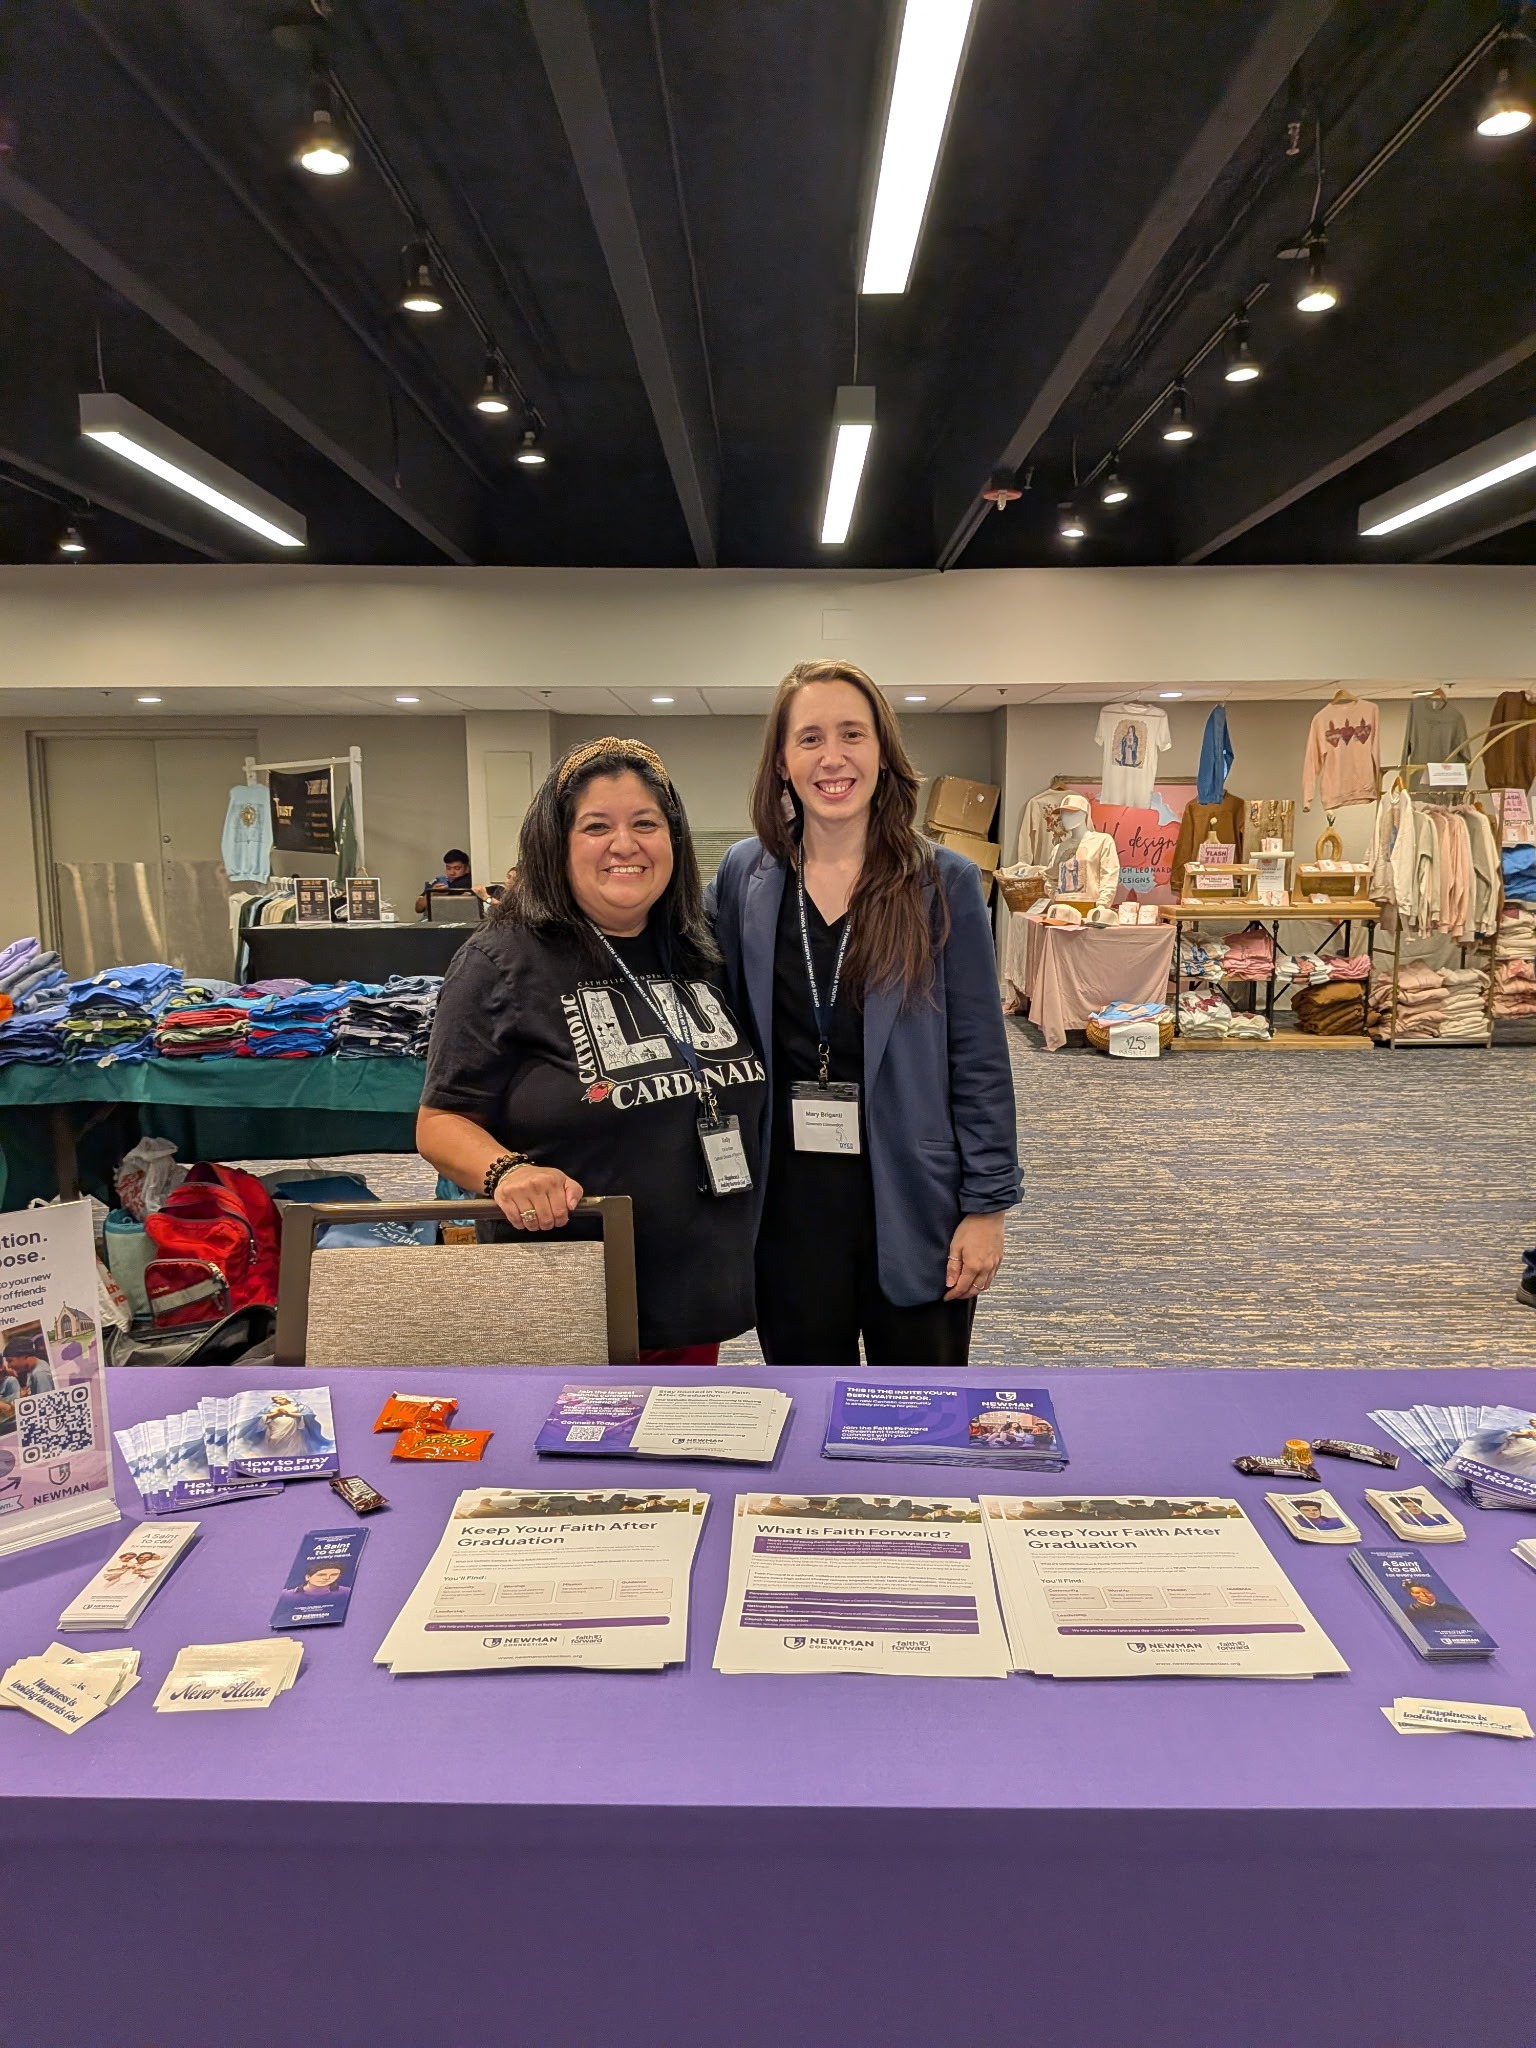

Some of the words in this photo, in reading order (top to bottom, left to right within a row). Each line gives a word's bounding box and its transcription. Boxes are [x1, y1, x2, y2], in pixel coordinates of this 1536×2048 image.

[1135, 866, 1171, 874] LEONARD
[1119, 876, 1150, 884] DESIGNS
[616, 957, 631, 975] OFFICE
[577, 977, 625, 988] CATHOLIC
[811, 988, 821, 1008] OFFICE
[560, 993, 598, 1085] CATHOLIC
[805, 1111, 820, 1119] Mary
[0, 1231, 48, 1250] tion.
[9, 1277, 30, 1290] your
[29, 1272, 51, 1282] new
[14, 1285, 47, 1299] friends
[241, 1459, 275, 1468] How
[296, 1456, 329, 1465] Pray
[246, 1465, 271, 1474] the
[273, 1463, 325, 1473] Rosary
[1456, 1458, 1492, 1474] How
[1494, 1471, 1511, 1482] to
[1458, 1464, 1483, 1477] the
[33, 1482, 90, 1506] NEWMAN
[189, 1487, 215, 1496] the
[461, 1525, 510, 1536] Keep
[515, 1525, 556, 1534] Your
[560, 1523, 605, 1533] Faith
[609, 1521, 658, 1531] After
[757, 1524, 803, 1535] What
[805, 1527, 820, 1535] is
[823, 1527, 865, 1536] Faith
[868, 1528, 951, 1539] Forward?
[1023, 1528, 1074, 1539] Keep
[1076, 1528, 1121, 1538] Your
[1122, 1527, 1170, 1537] Faith
[1173, 1526, 1221, 1537] After
[323, 1542, 351, 1550] Saint
[457, 1536, 565, 1547] Graduation
[1028, 1539, 1138, 1549] Graduation
[1391, 1560, 1420, 1568] Saint
[810, 1637, 875, 1647] NEWMAN
[33, 1678, 72, 1705] Happiness
[170, 1684, 220, 1700] Never
[221, 1681, 272, 1699] Alone
[10, 1680, 38, 1701] looking
[35, 1694, 66, 1716] towards
[63, 1710, 83, 1723] God
[1403, 1711, 1443, 1723] looking
